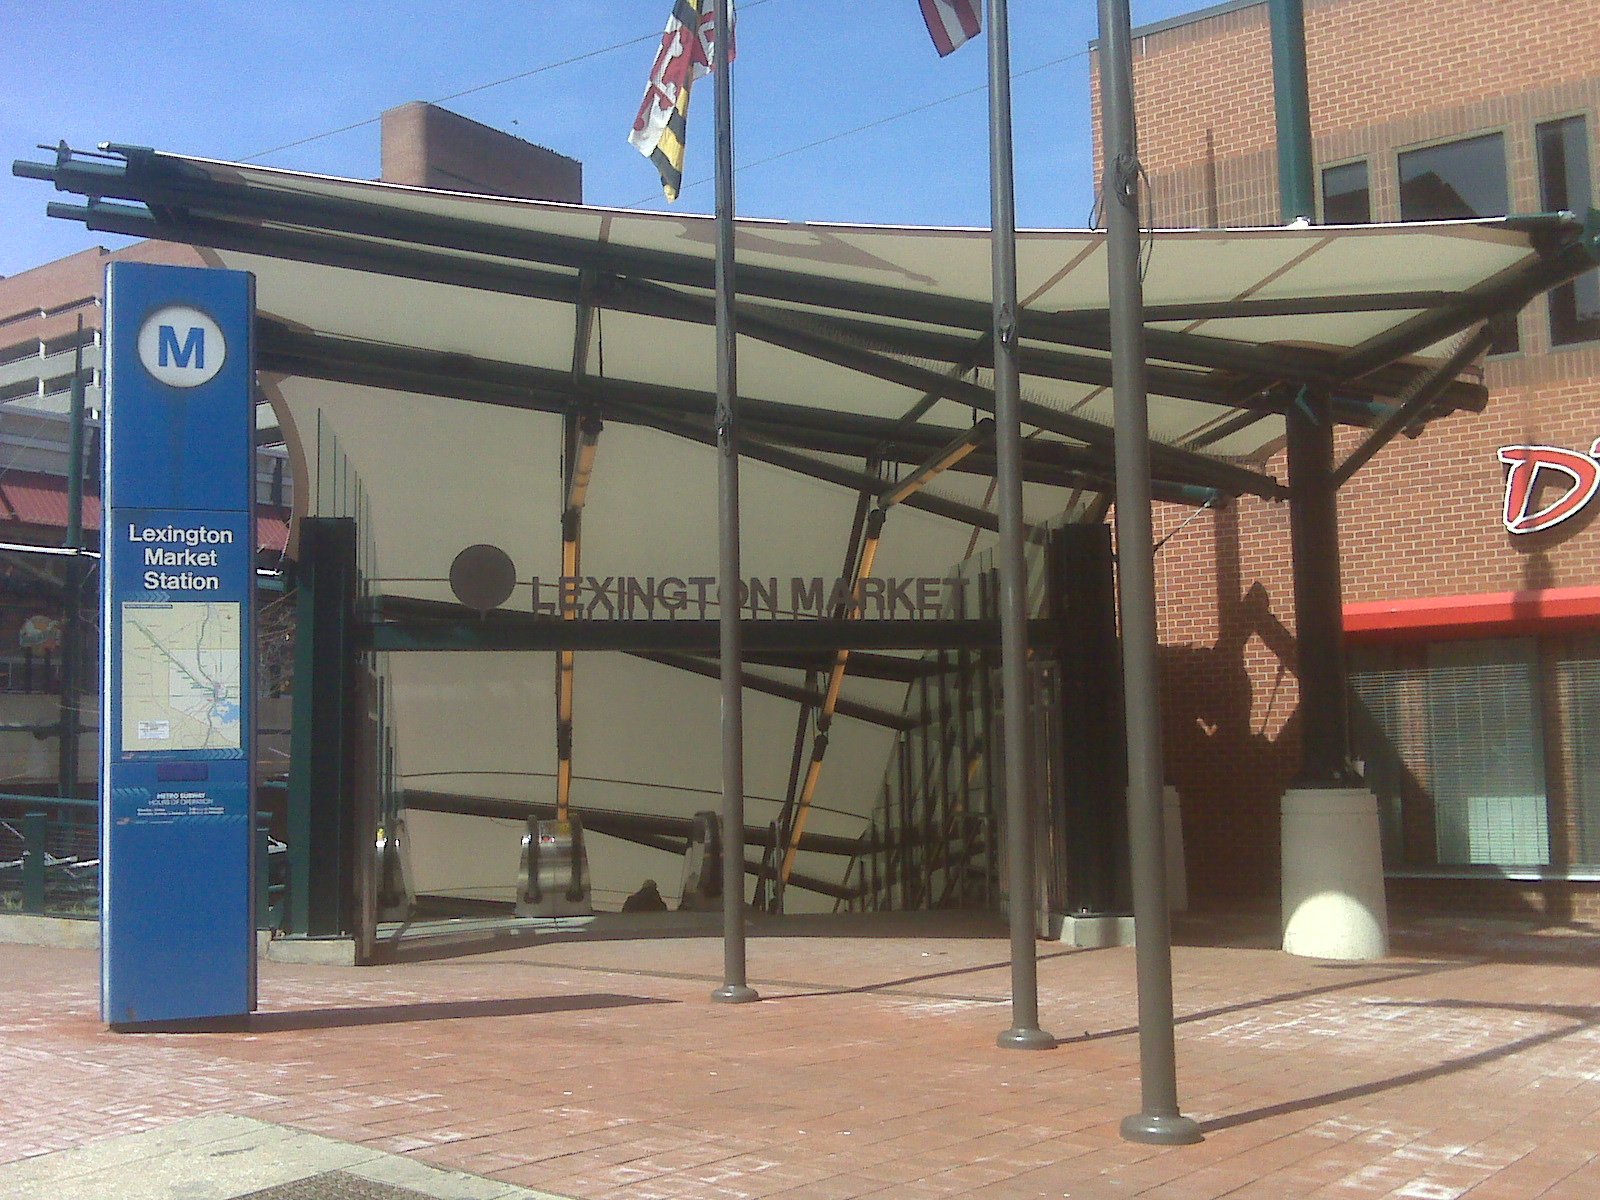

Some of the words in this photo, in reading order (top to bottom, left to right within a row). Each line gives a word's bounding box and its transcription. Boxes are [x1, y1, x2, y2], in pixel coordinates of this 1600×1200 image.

[158, 325, 205, 369] M
[129, 523, 233, 546] Lexington
[144, 547, 217, 567] Market
[144, 570, 219, 590] Station
[791, 577, 970, 611] MARKET
